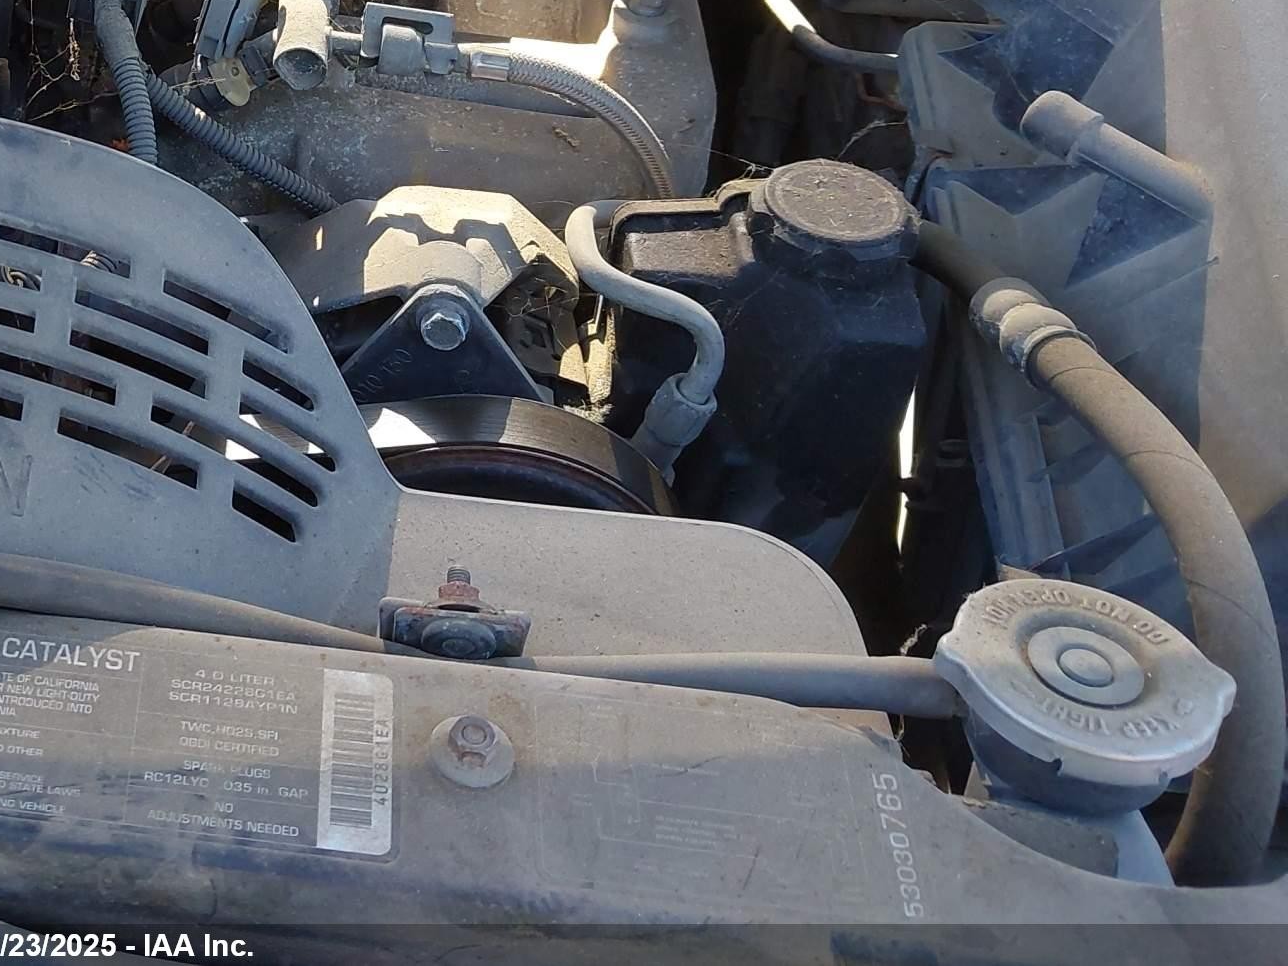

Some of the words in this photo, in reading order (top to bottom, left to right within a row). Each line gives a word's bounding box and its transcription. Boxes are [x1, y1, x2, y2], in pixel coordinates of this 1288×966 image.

[1012, 587, 1073, 613] OPEN
[1079, 597, 1132, 625] NOT
[1135, 619, 1170, 645] DO
[1, 636, 142, 673] CATALYST
[6, 683, 35, 696] NEW
[16, 673, 33, 684] OF
[33, 675, 101, 693] CALIFORNIA
[229, 672, 275, 686] LITER
[66, 701, 94, 714] INTO
[1037, 696, 1112, 737] TIGHT
[7, 745, 44, 757] OTHER
[214, 740, 281, 758] CERTIFIED
[9, 781, 44, 794] STATE
[144, 771, 210, 789] RC12LYC
[277, 785, 310, 799] GAP
[214, 801, 235, 814] NO
[146, 808, 244, 831] ADJUSTMENTS
[246, 821, 300, 838] NEEDED
[871, 772, 925, 919] 53030765
